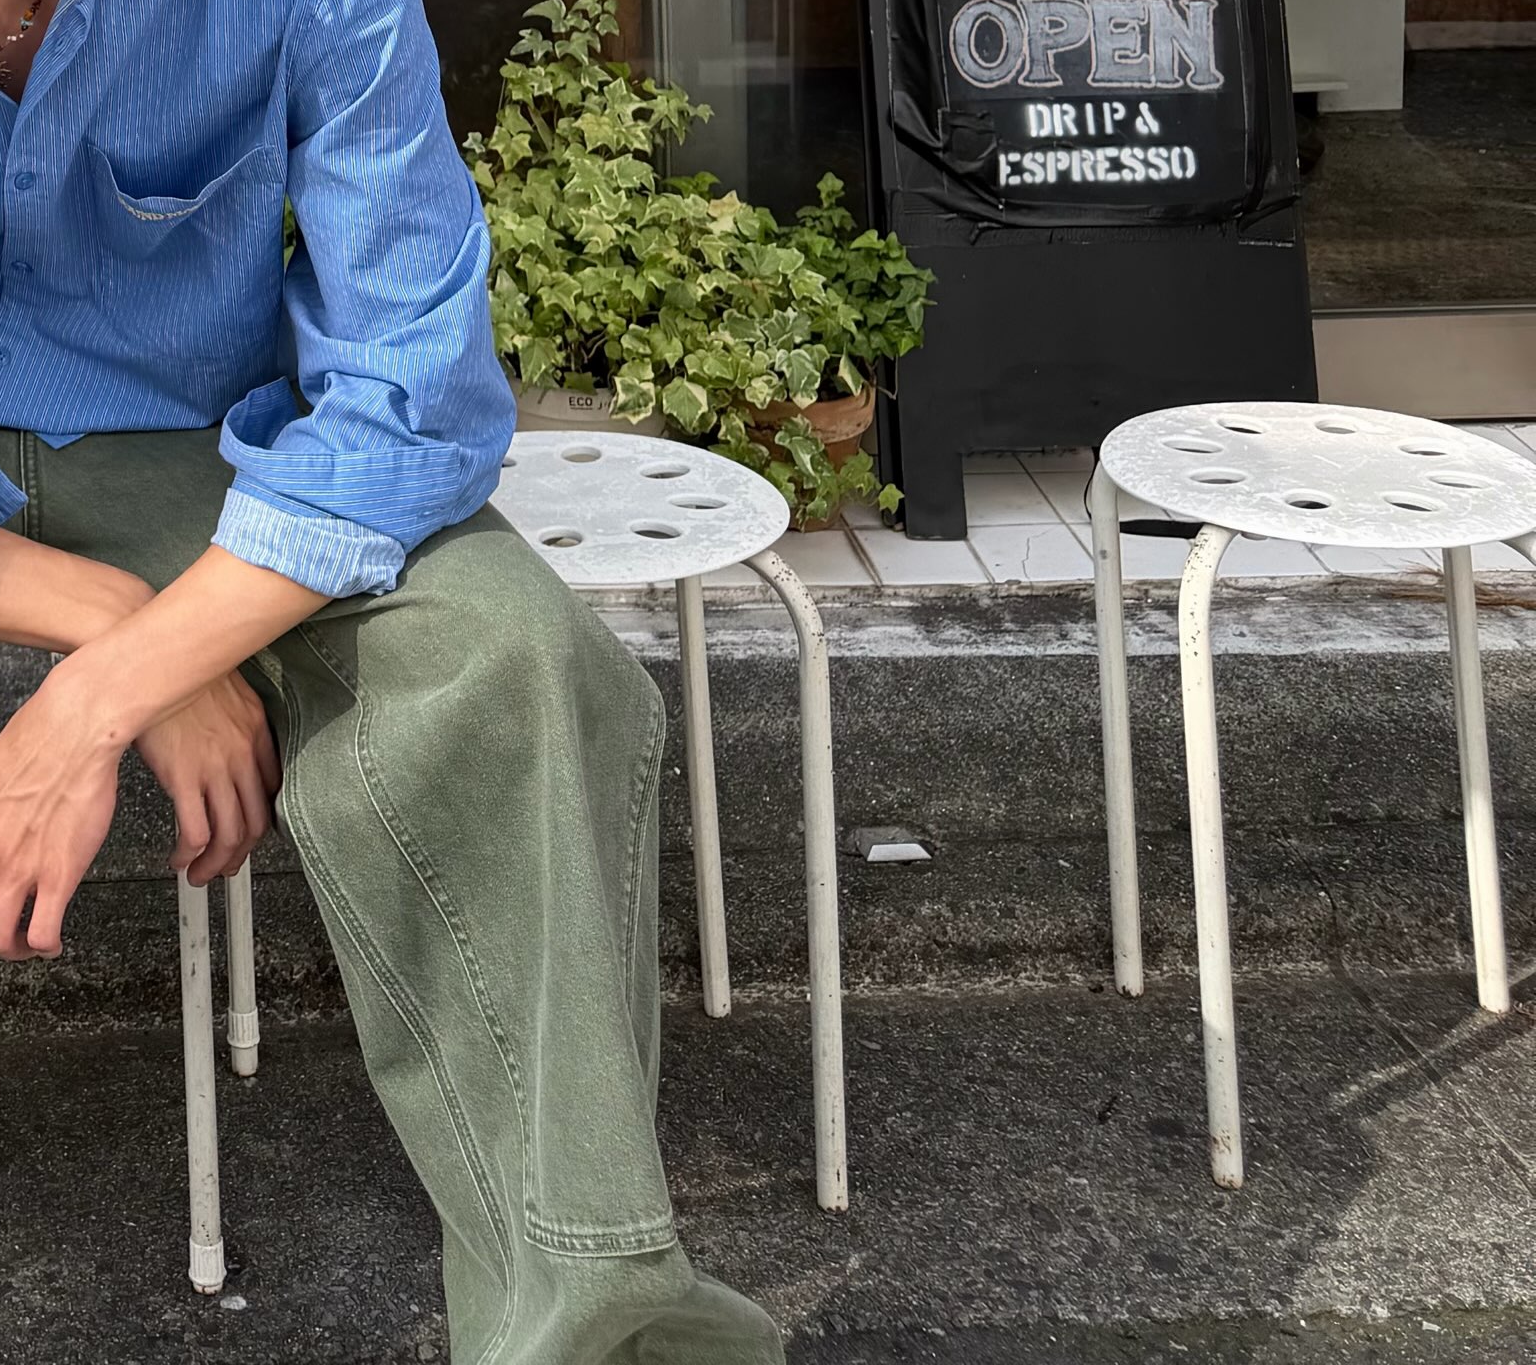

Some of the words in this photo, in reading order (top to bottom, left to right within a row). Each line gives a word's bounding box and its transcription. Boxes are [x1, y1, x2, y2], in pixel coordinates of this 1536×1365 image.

[1026, 101, 1125, 137] DRIP
[1135, 102, 1160, 135] &
[998, 145, 1196, 187] ESPRESSO
